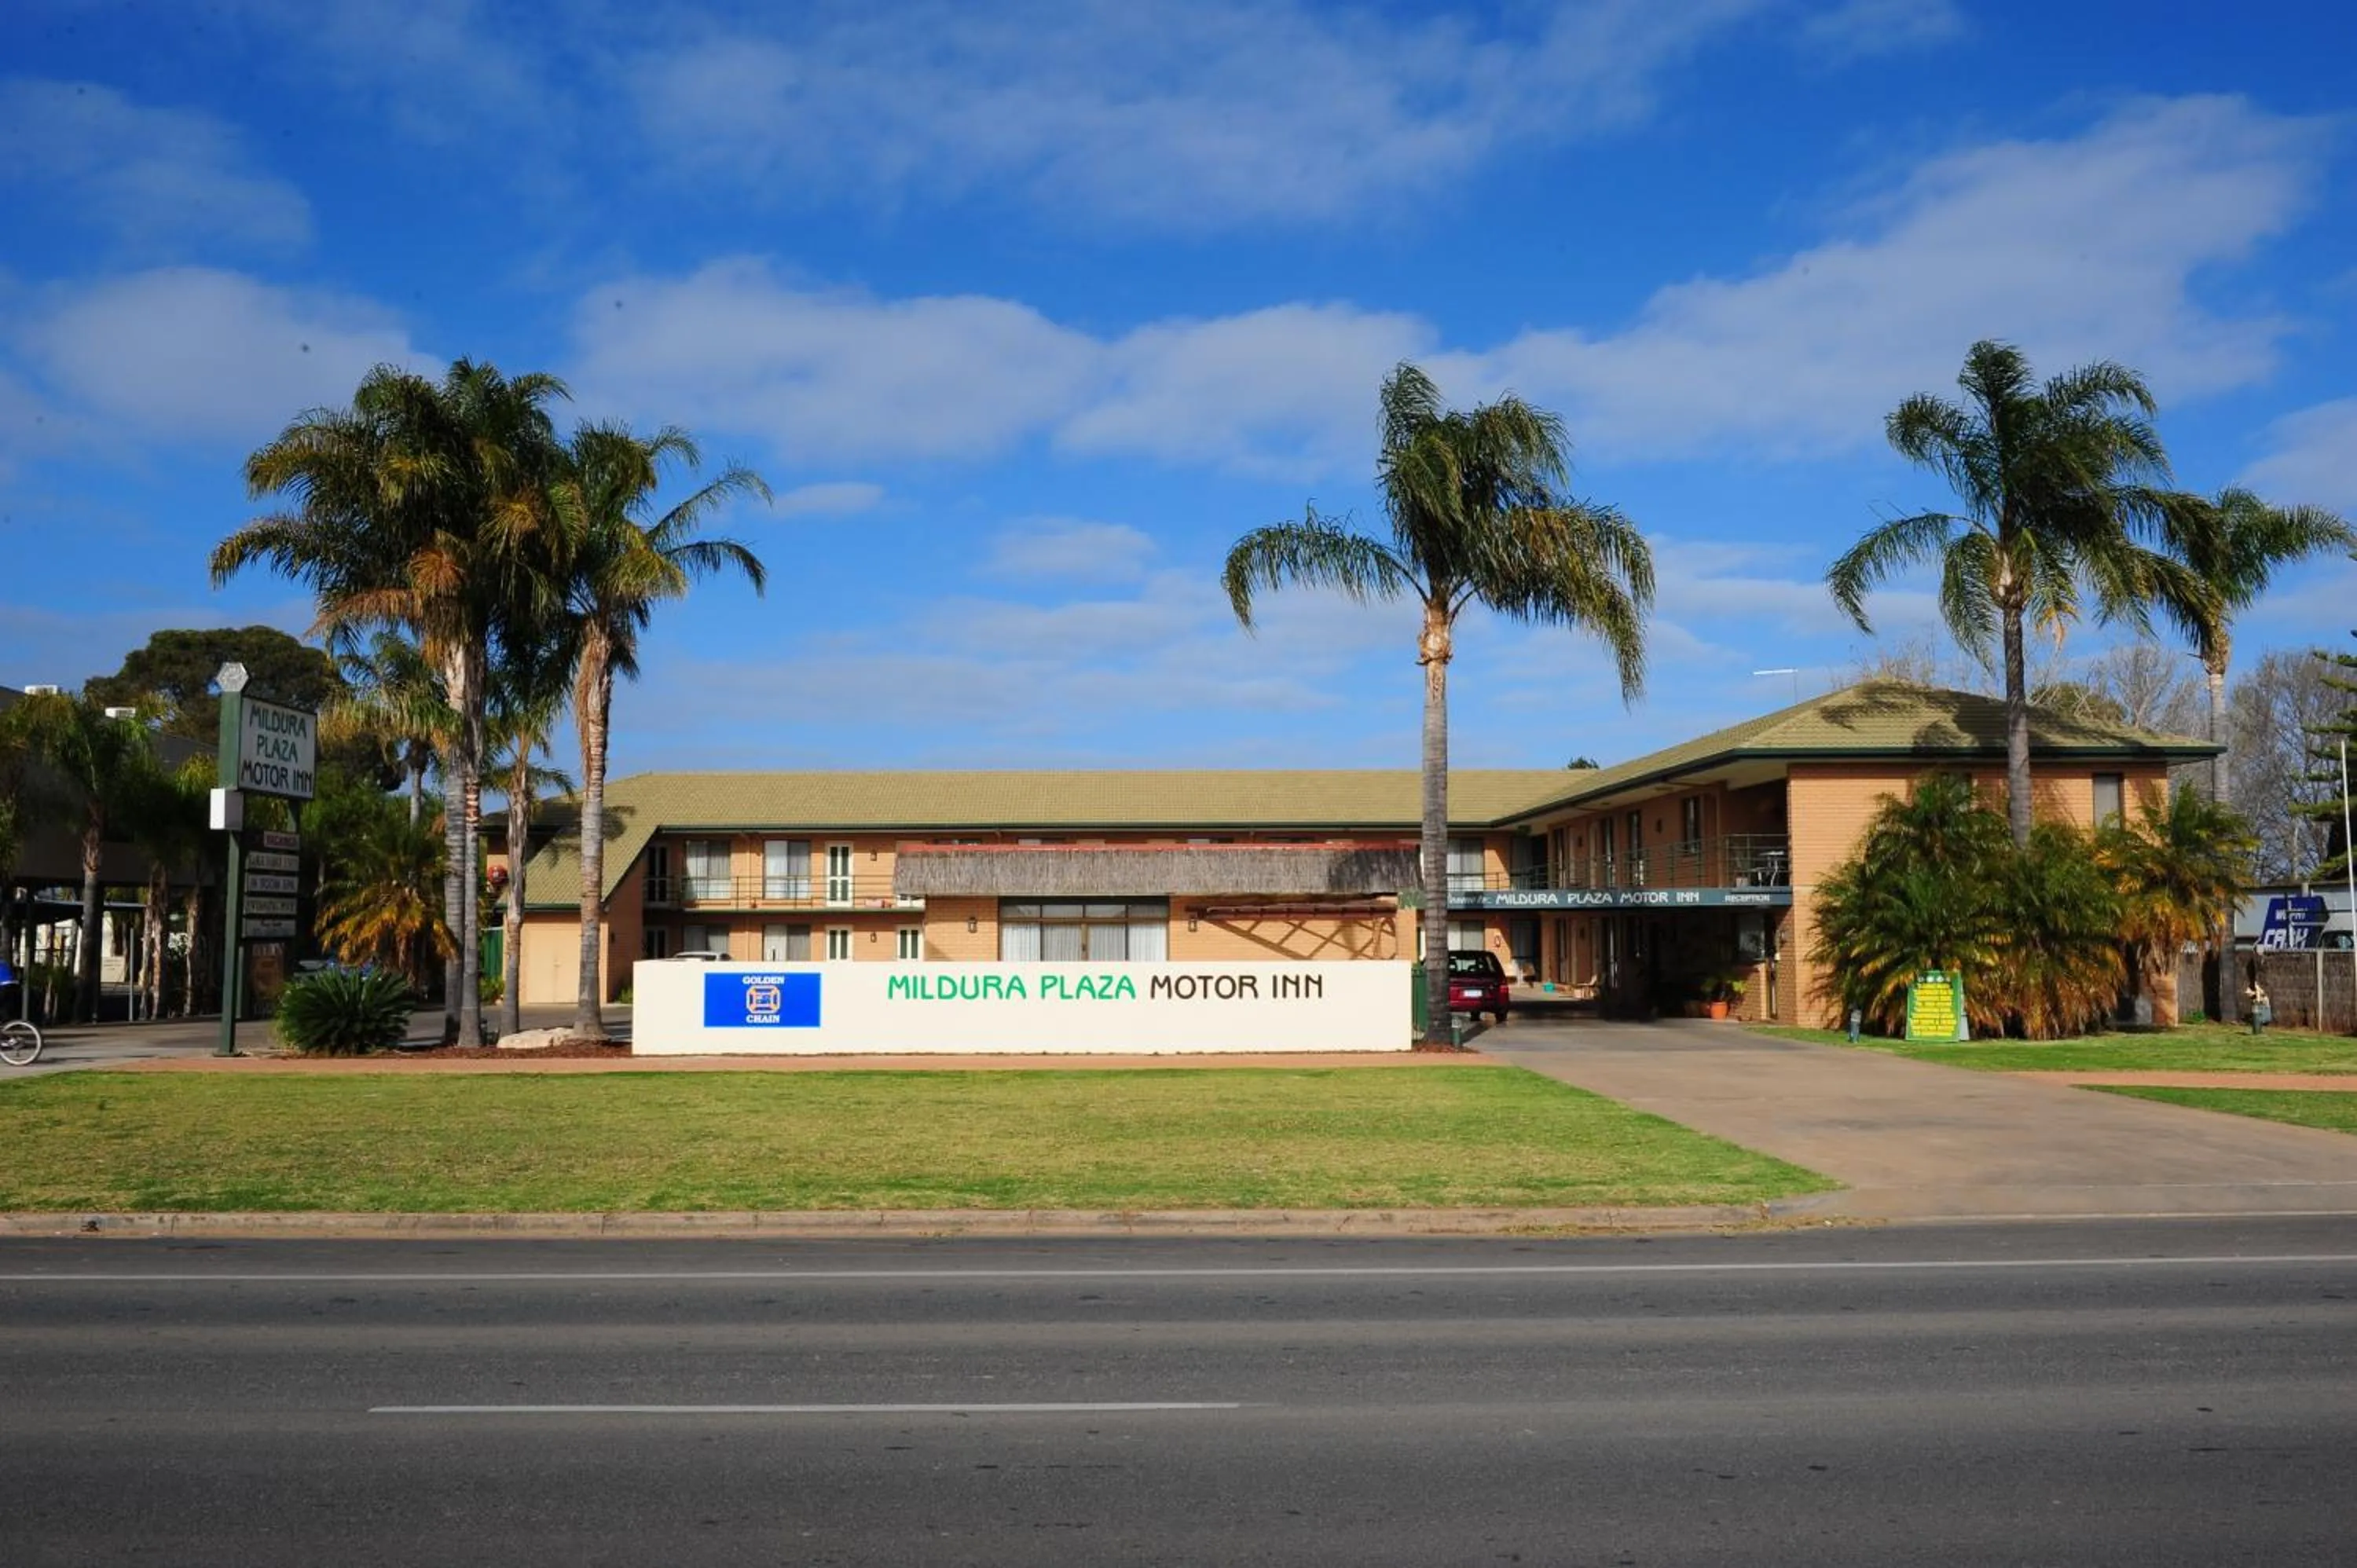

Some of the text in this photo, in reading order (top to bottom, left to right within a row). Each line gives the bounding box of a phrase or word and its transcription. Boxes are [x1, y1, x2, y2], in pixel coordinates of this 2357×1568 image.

[250, 705, 306, 738] MILDURA
[256, 734, 298, 763] PLAZA
[241, 759, 313, 792] MOTOR INN
[1496, 893, 1559, 904] MILDURA
[1567, 892, 1612, 903] PLAZA
[1619, 892, 1669, 903] MOTOR
[1677, 892, 1699, 903] INN
[1725, 894, 1770, 903] RECEPTION
[742, 976, 785, 984] GOLDEN
[888, 974, 1323, 1000] MILDURA PLAZA MOTOR INN
[746, 1014, 780, 1024] CHAIN
